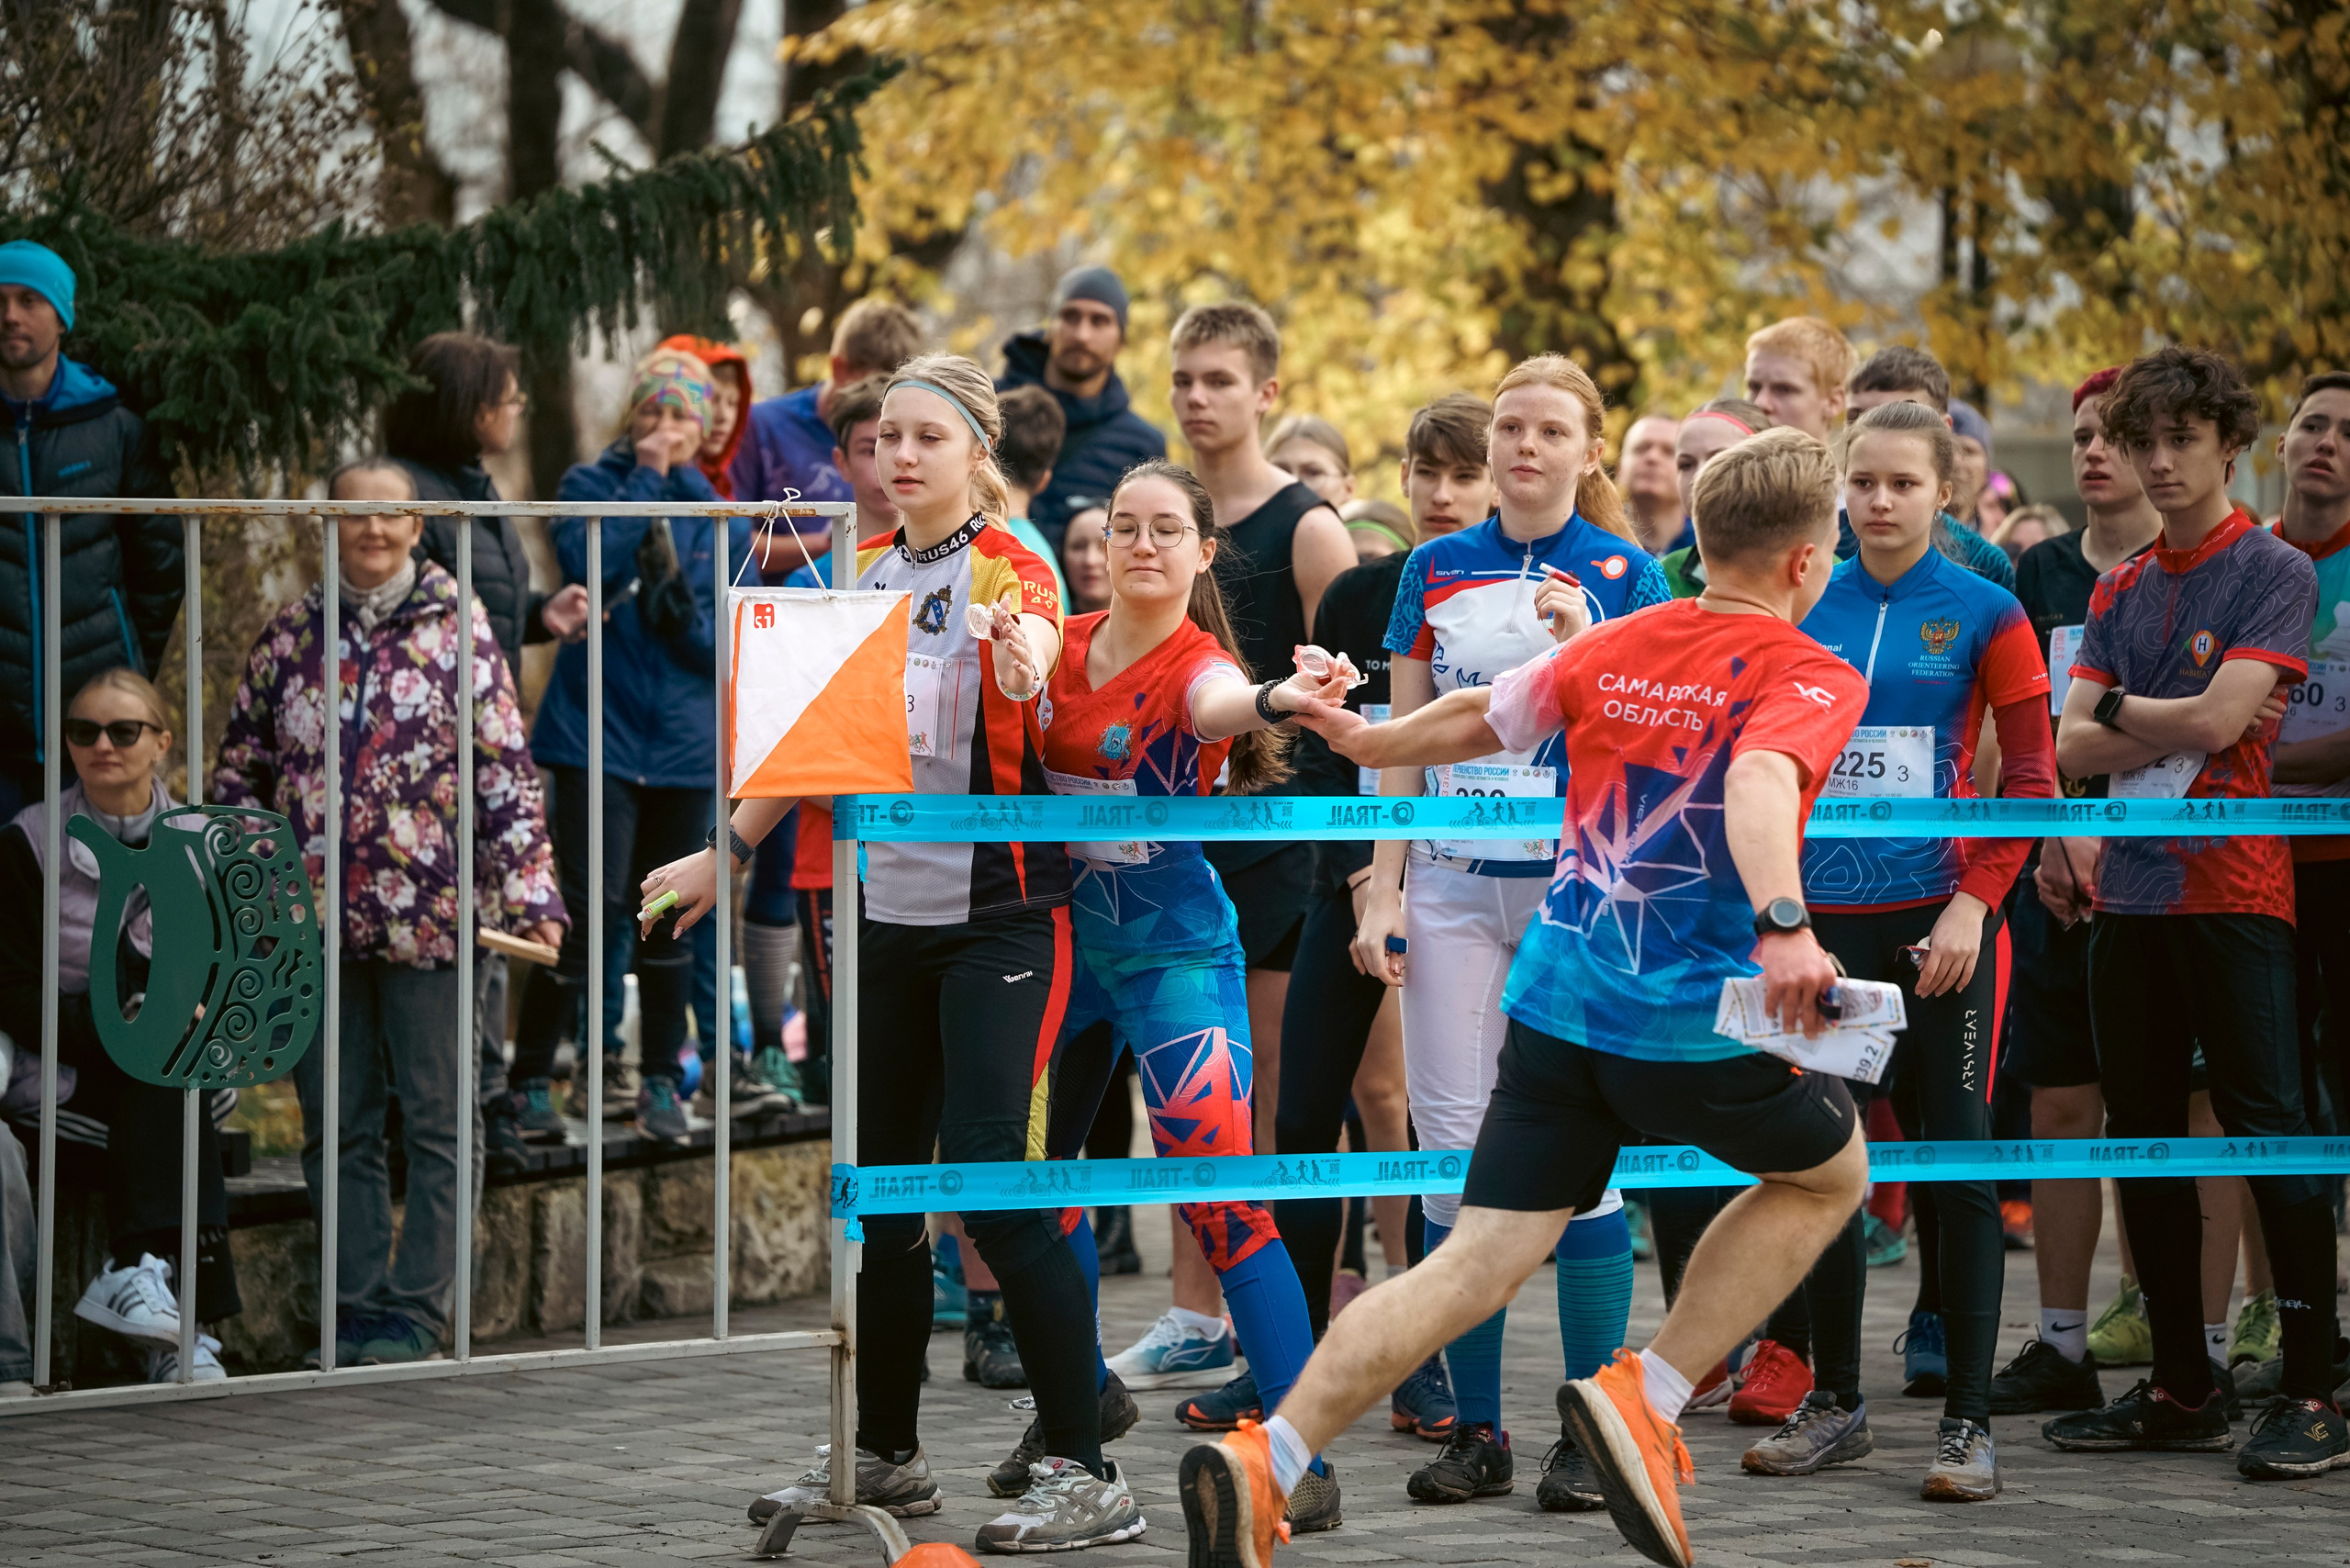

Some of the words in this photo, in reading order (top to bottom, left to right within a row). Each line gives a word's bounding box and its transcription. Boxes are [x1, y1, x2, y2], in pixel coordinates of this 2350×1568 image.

[918, 531, 968, 562] RUS46
[1024, 580, 1058, 602] RUS
[1365, 659, 1380, 671] TO
[1908, 661, 1960, 670] ORIENTEERING
[1919, 655, 1951, 663] RUSSIAN
[1911, 669, 1955, 678] FEDERATION
[2334, 696, 2346, 712] 3
[1861, 729, 1887, 738] РОССИИ
[1453, 764, 1483, 776] ПЕРВЕНСТВО
[1483, 767, 1510, 777] РОССИИ
[1832, 751, 1886, 778] 225
[2175, 756, 2185, 774] 3
[1897, 765, 1909, 782] 3
[1828, 777, 1859, 790] МЖ16
